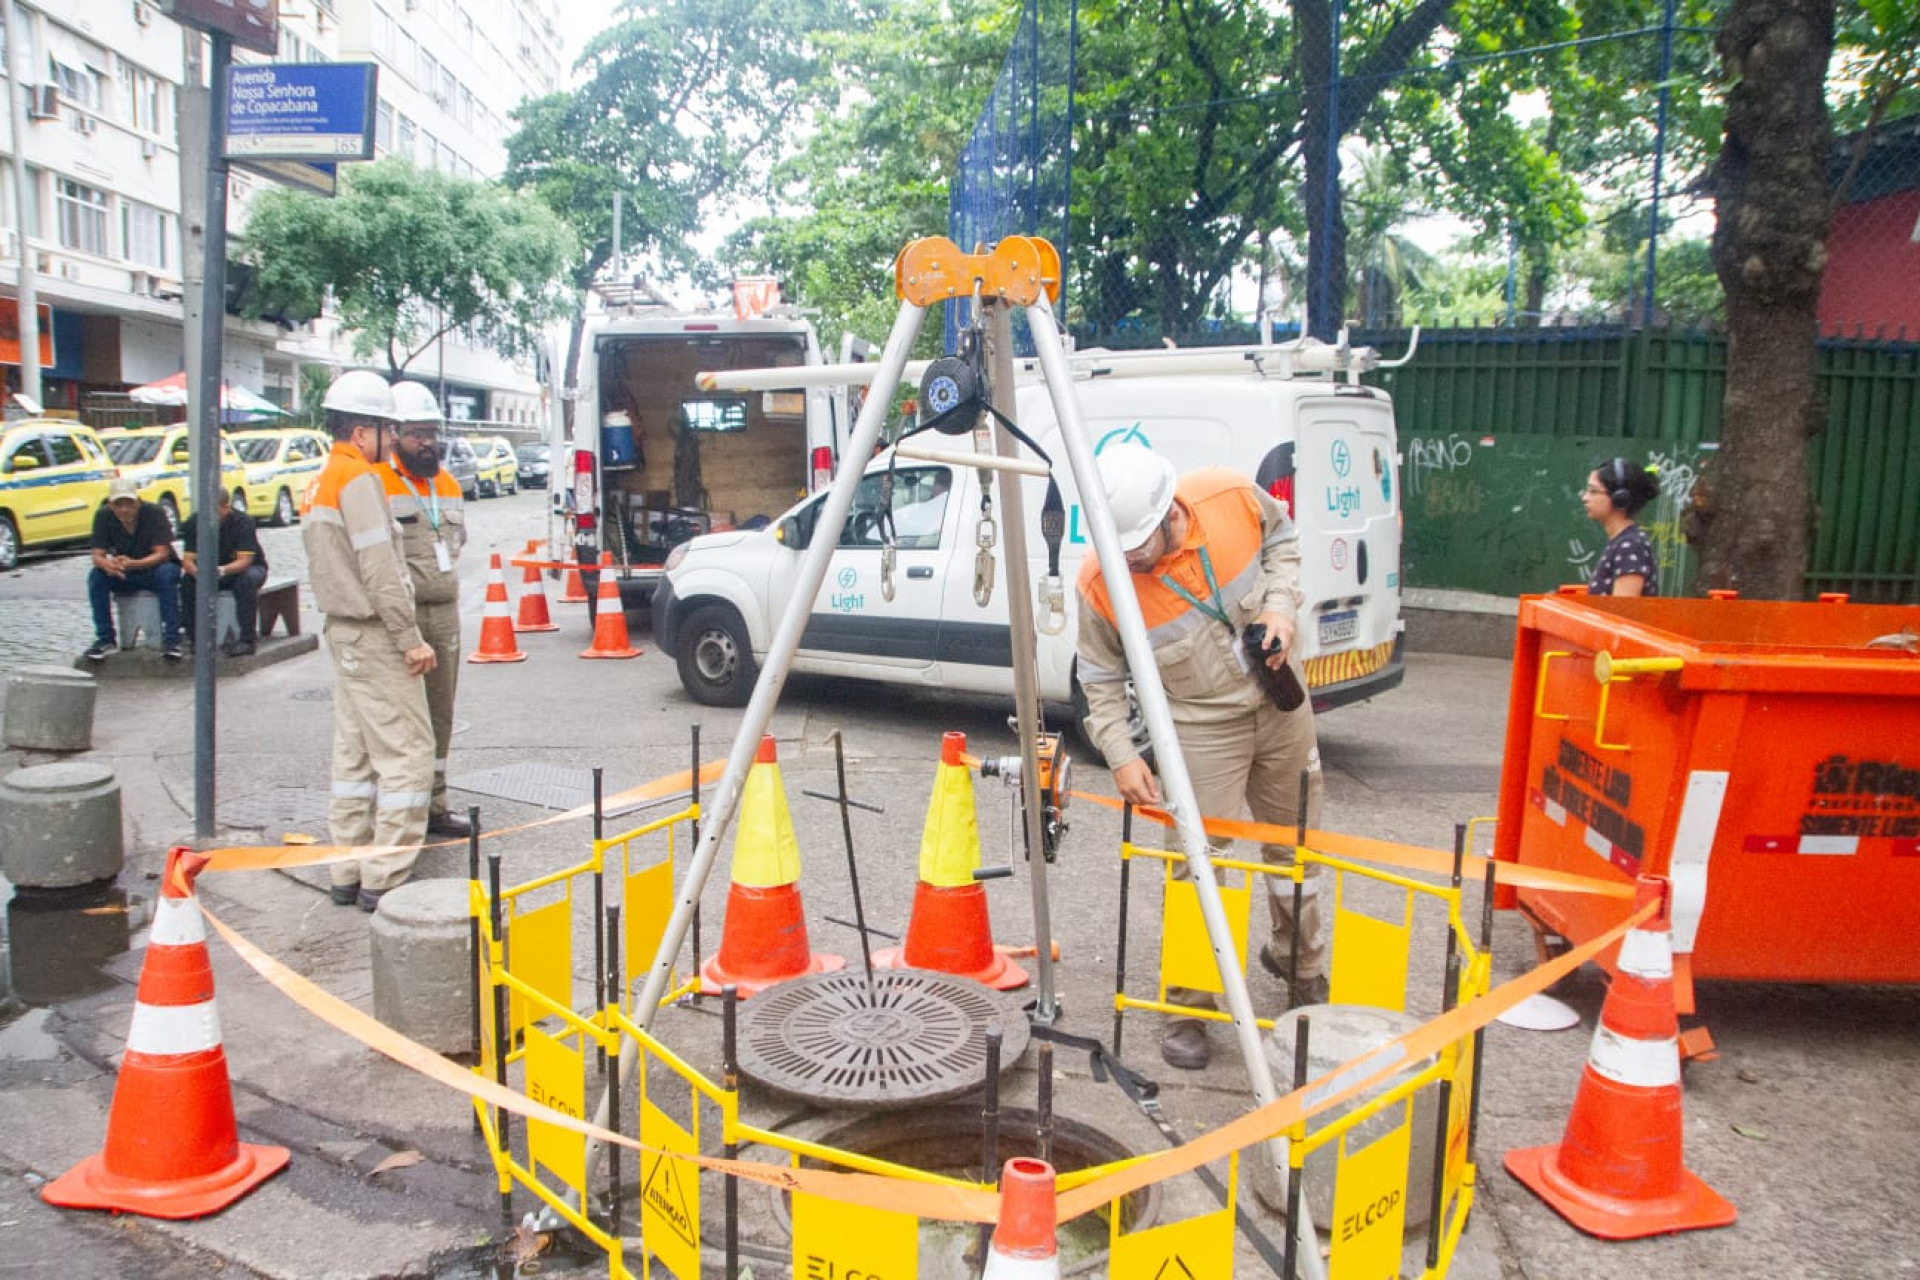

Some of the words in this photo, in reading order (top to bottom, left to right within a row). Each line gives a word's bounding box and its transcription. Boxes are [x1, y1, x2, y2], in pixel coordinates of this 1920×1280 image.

[233, 70, 275, 84] Avenida
[232, 86, 264, 99] Nossa
[267, 83, 315, 98] Senhora
[231, 101, 246, 115] de
[248, 99, 318, 117] Copacabana
[334, 138, 357, 154] 165
[1326, 485, 1361, 518] Light
[831, 592, 865, 613] Light
[1341, 1189, 1400, 1243] ELCOP
